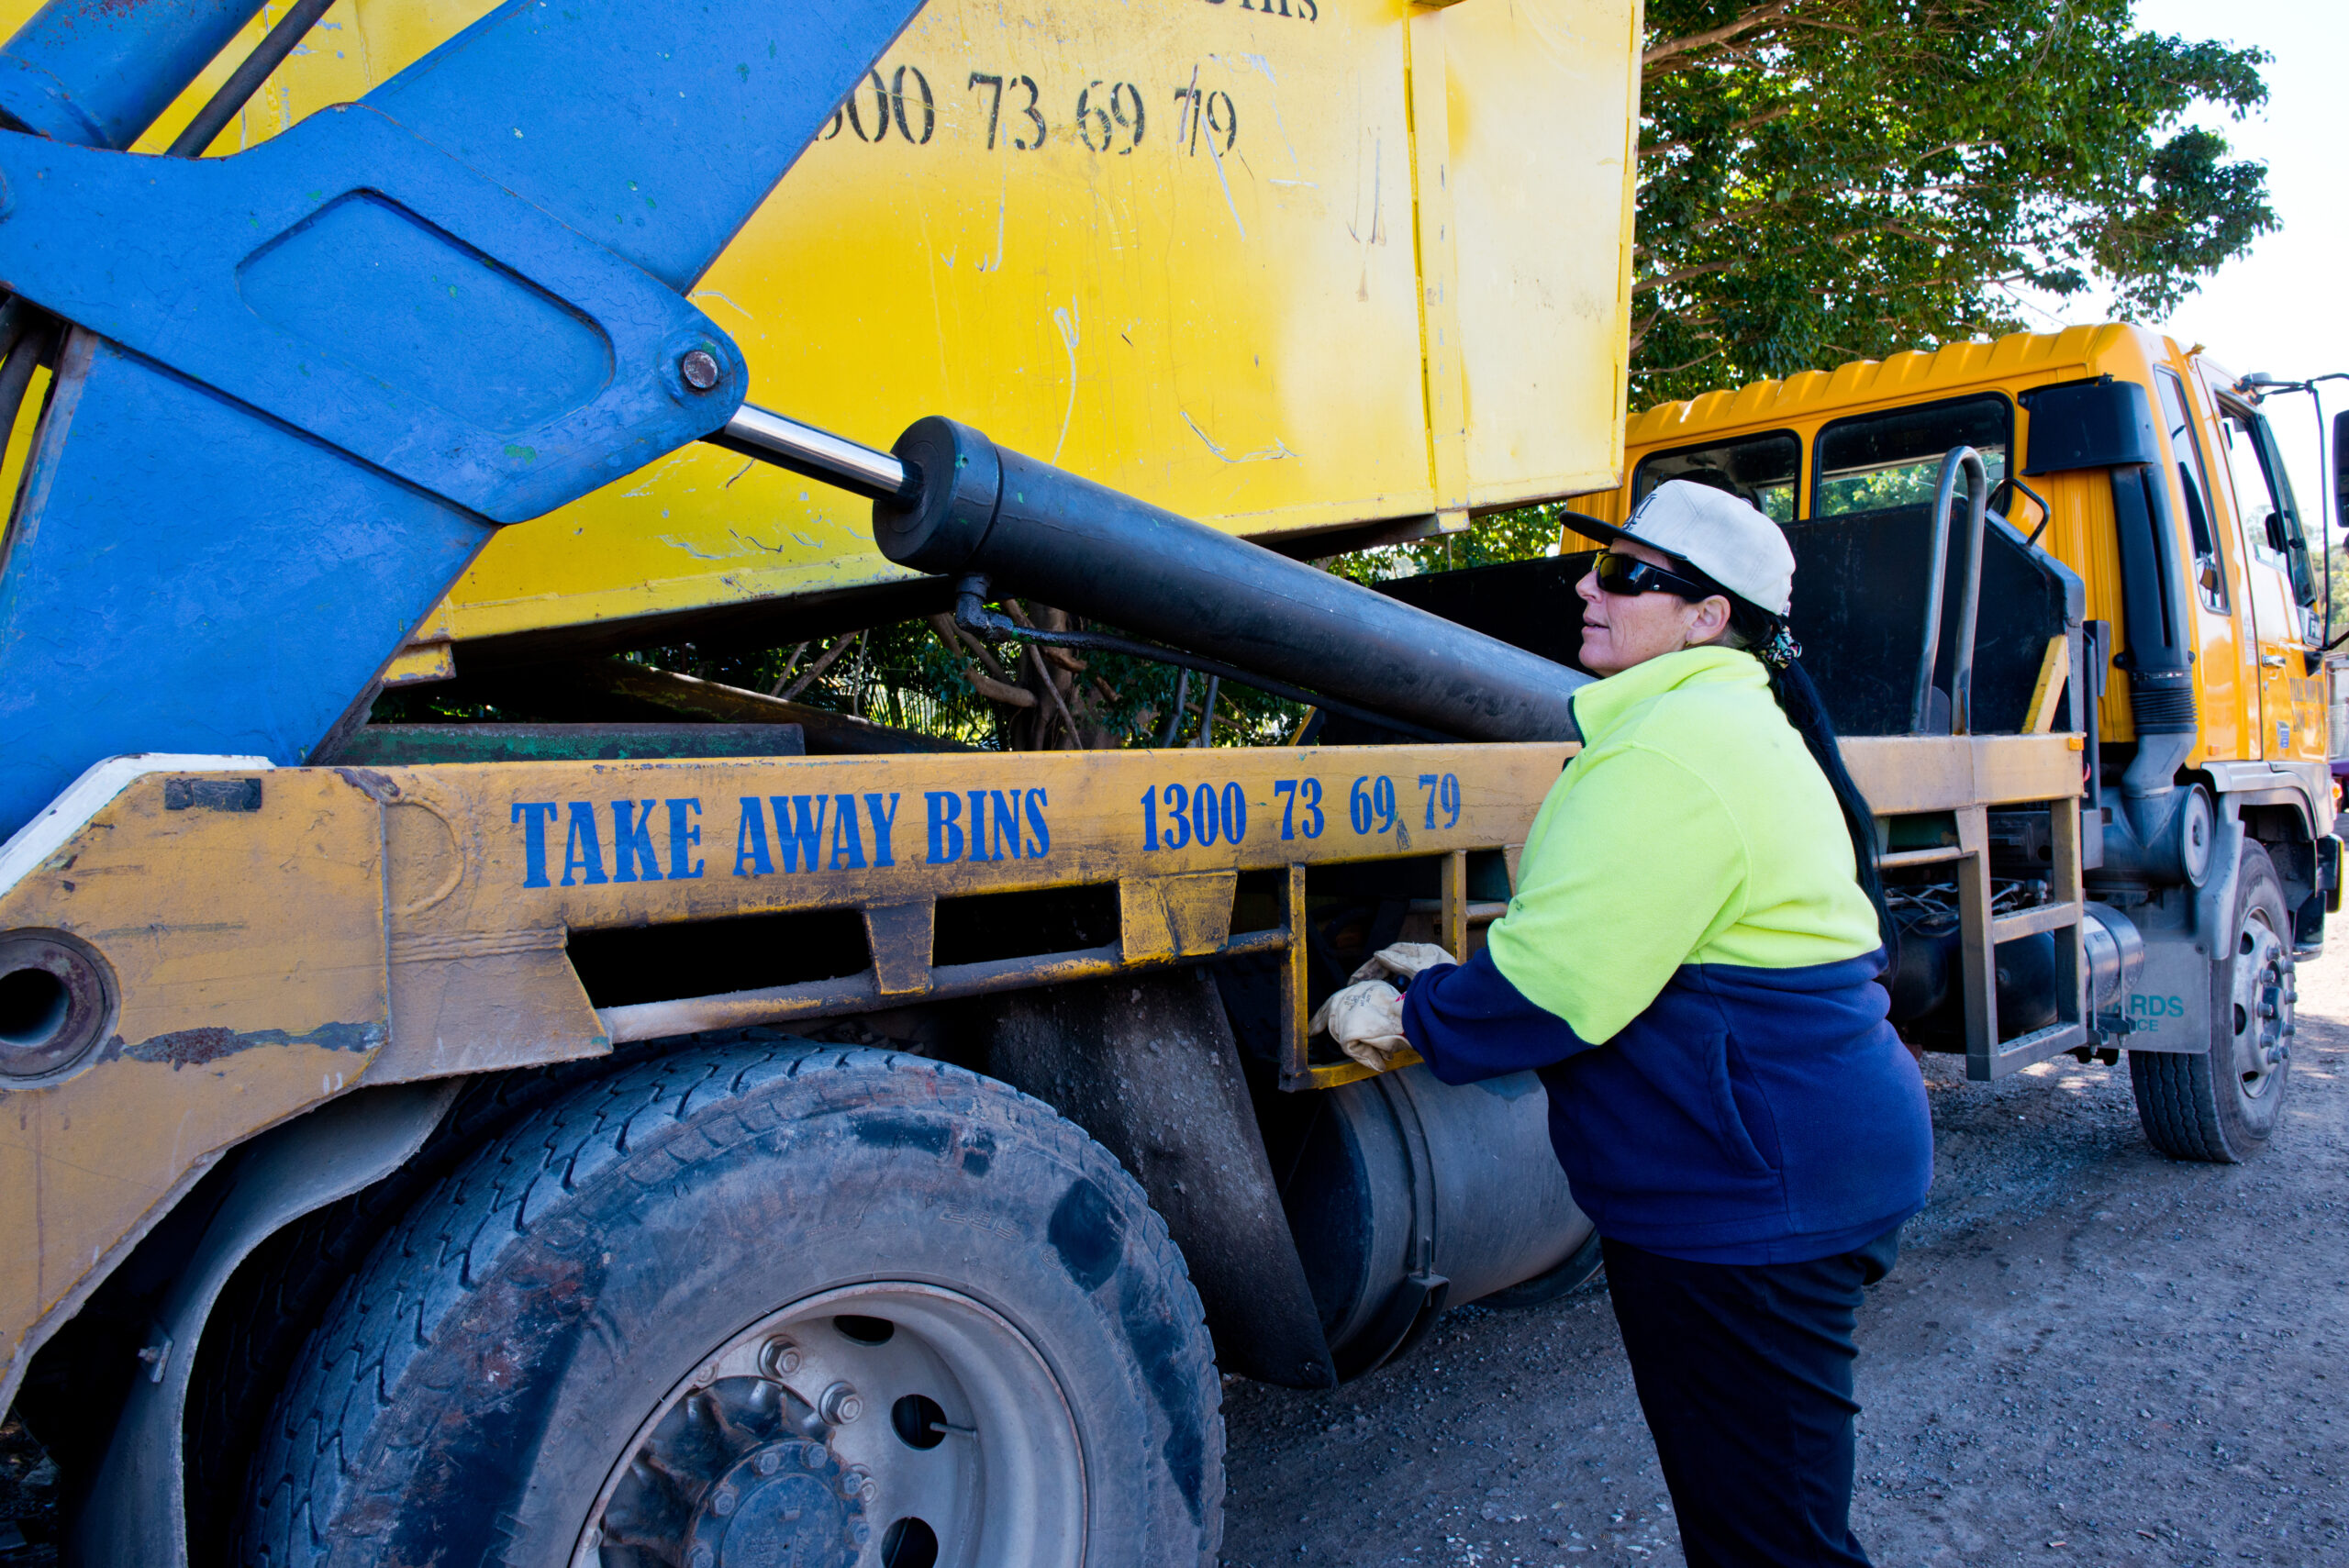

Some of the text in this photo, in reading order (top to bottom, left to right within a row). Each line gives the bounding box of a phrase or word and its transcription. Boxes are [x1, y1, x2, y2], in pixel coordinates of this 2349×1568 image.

[968, 72, 1046, 150] 73
[1077, 81, 1144, 155] 69
[1174, 88, 1236, 157] 79
[511, 773, 1461, 889] TAKE AWAY BINS 1300 73 69 79
